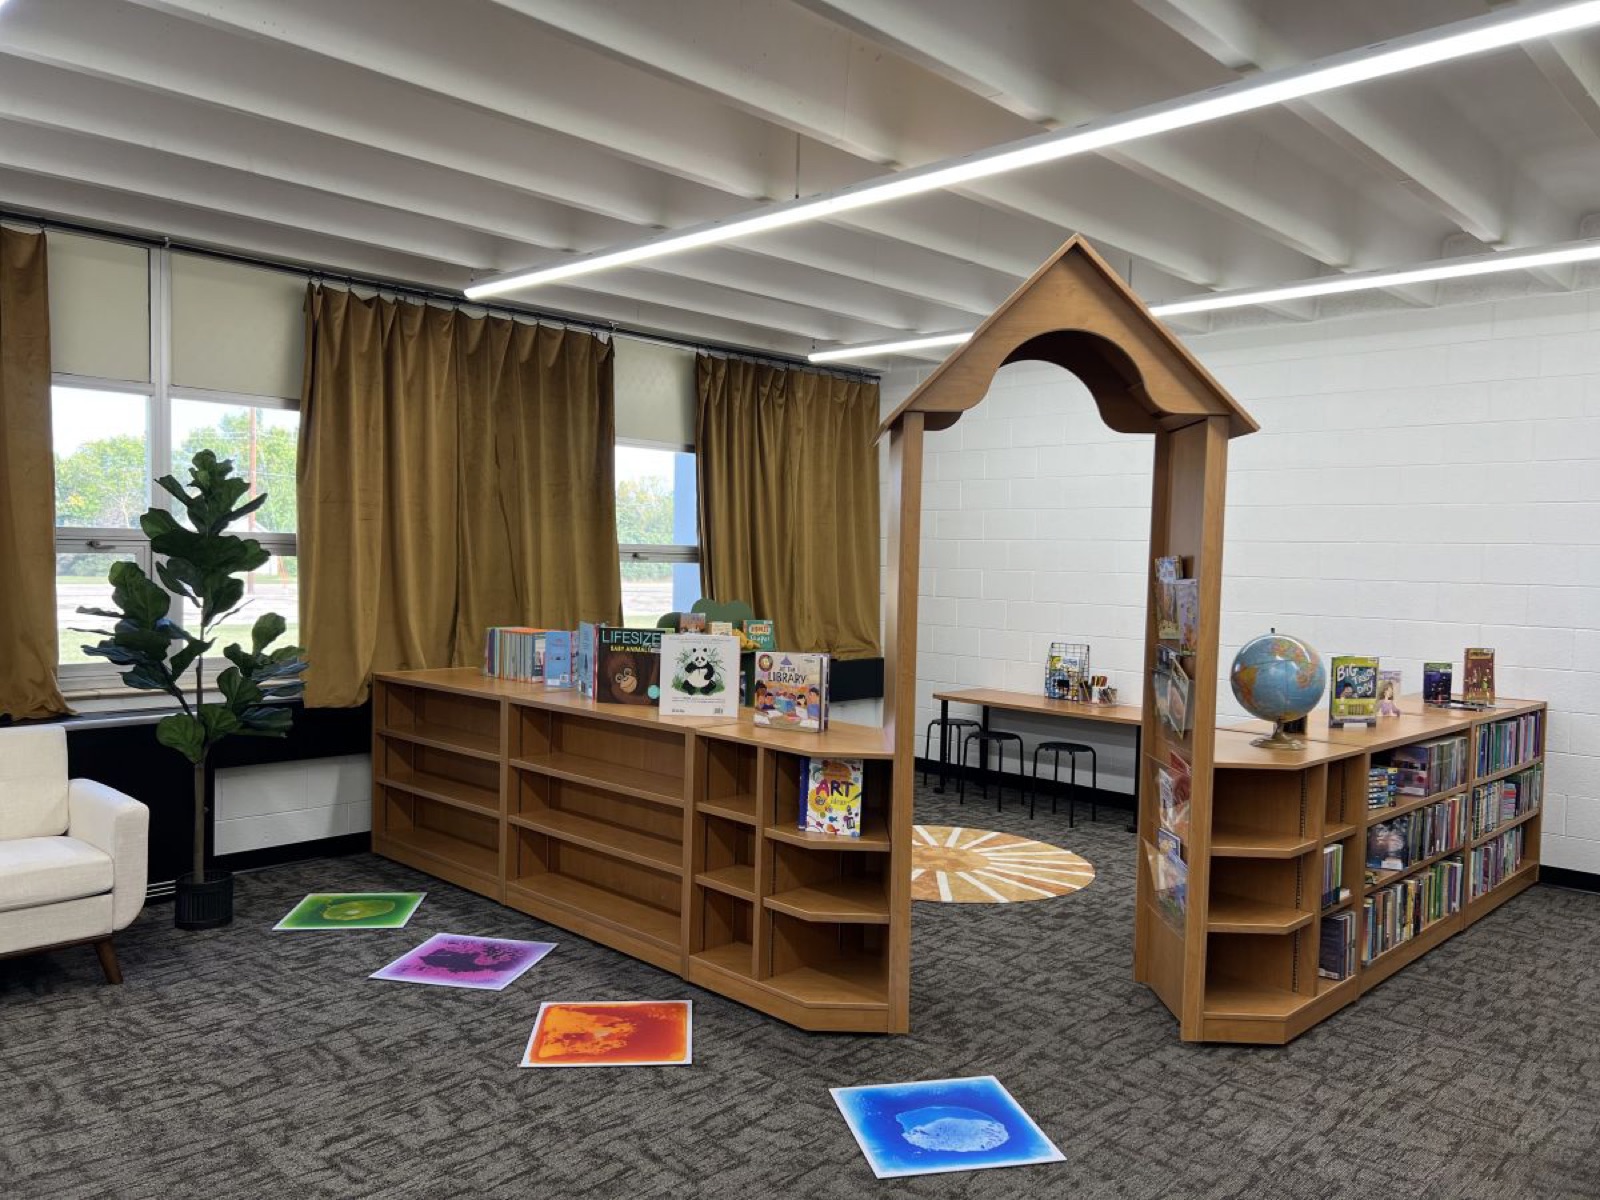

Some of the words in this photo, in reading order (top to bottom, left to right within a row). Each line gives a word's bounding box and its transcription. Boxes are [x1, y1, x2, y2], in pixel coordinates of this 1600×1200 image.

[602, 630, 661, 646] LIFESIZE
[625, 645, 658, 653] ANIMAL
[768, 671, 807, 683] LIBRARY
[1336, 664, 1358, 682] BIG
[815, 779, 854, 797] ART
